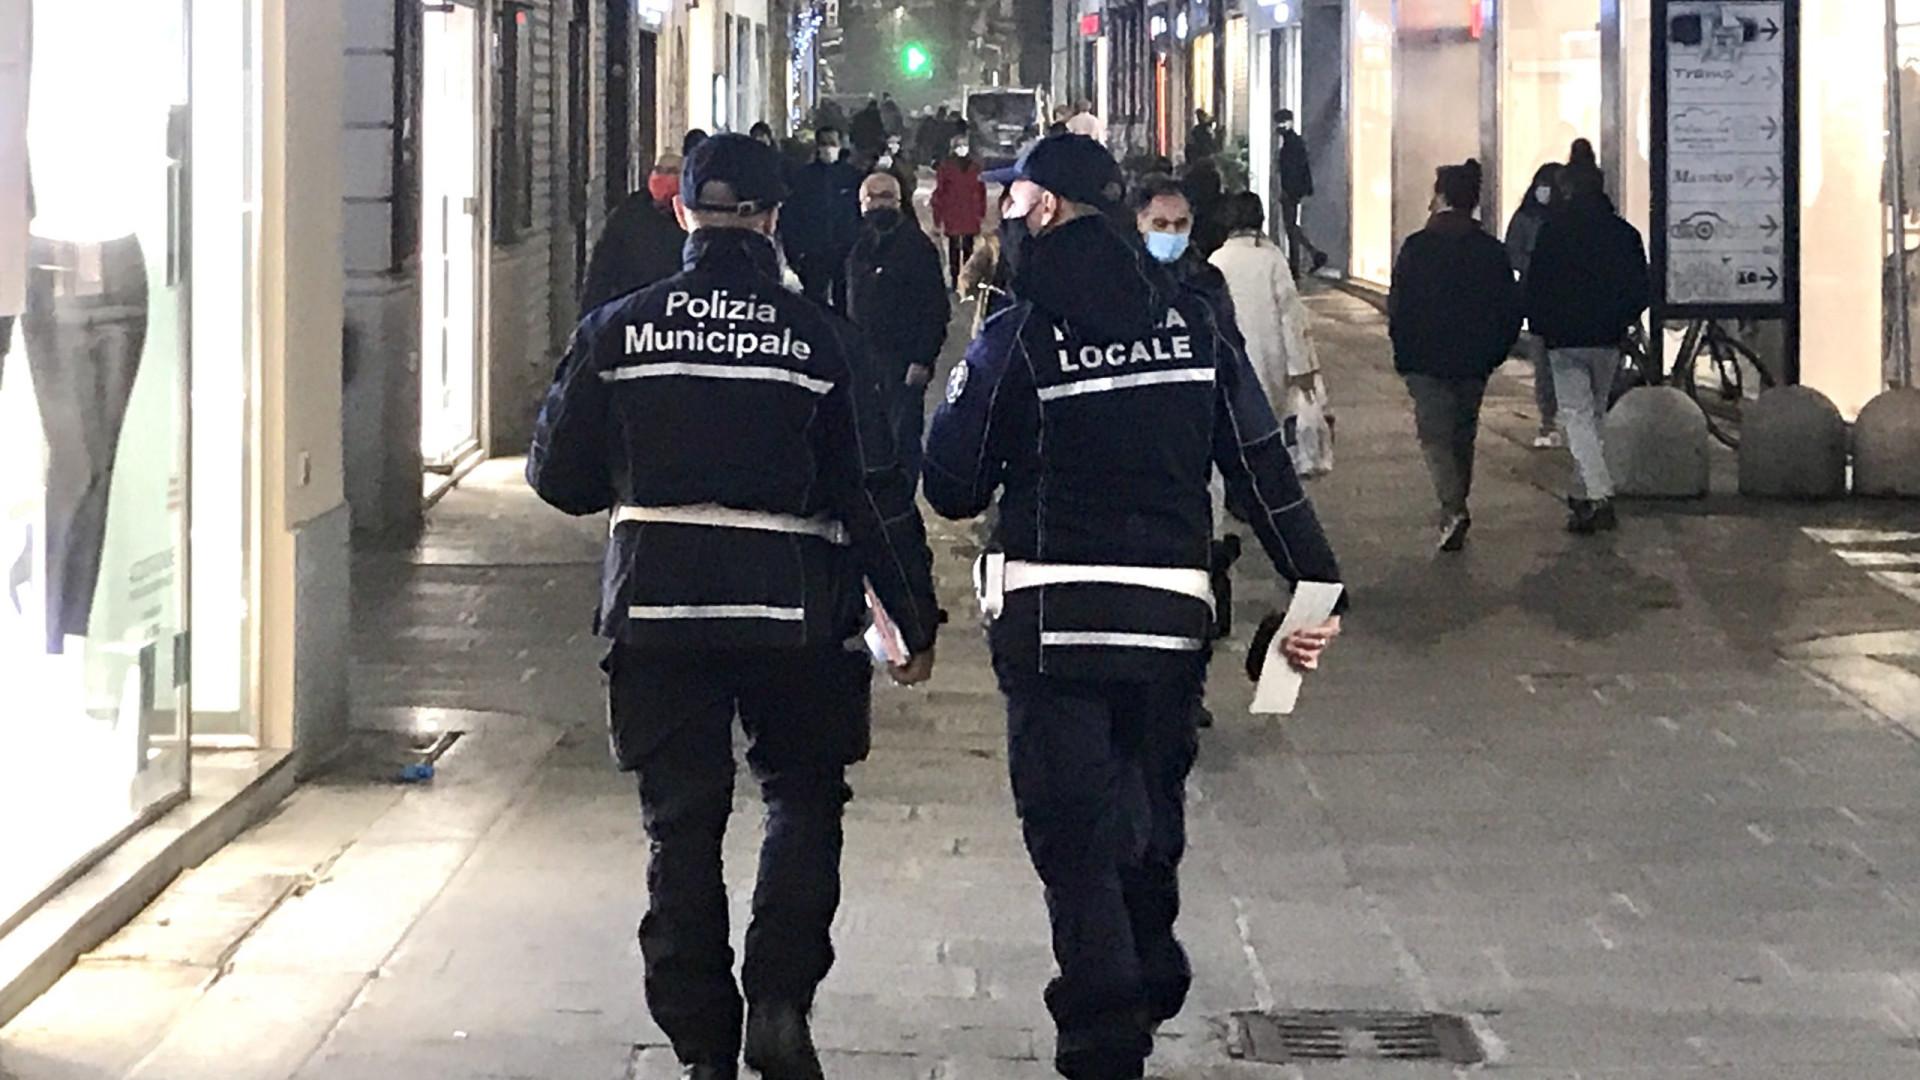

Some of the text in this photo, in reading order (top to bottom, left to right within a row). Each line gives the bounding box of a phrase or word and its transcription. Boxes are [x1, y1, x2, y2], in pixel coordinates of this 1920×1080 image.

[666, 290, 777, 323] Polizia
[625, 322, 812, 360] Municipale
[1058, 335, 1193, 372] LOCALE
